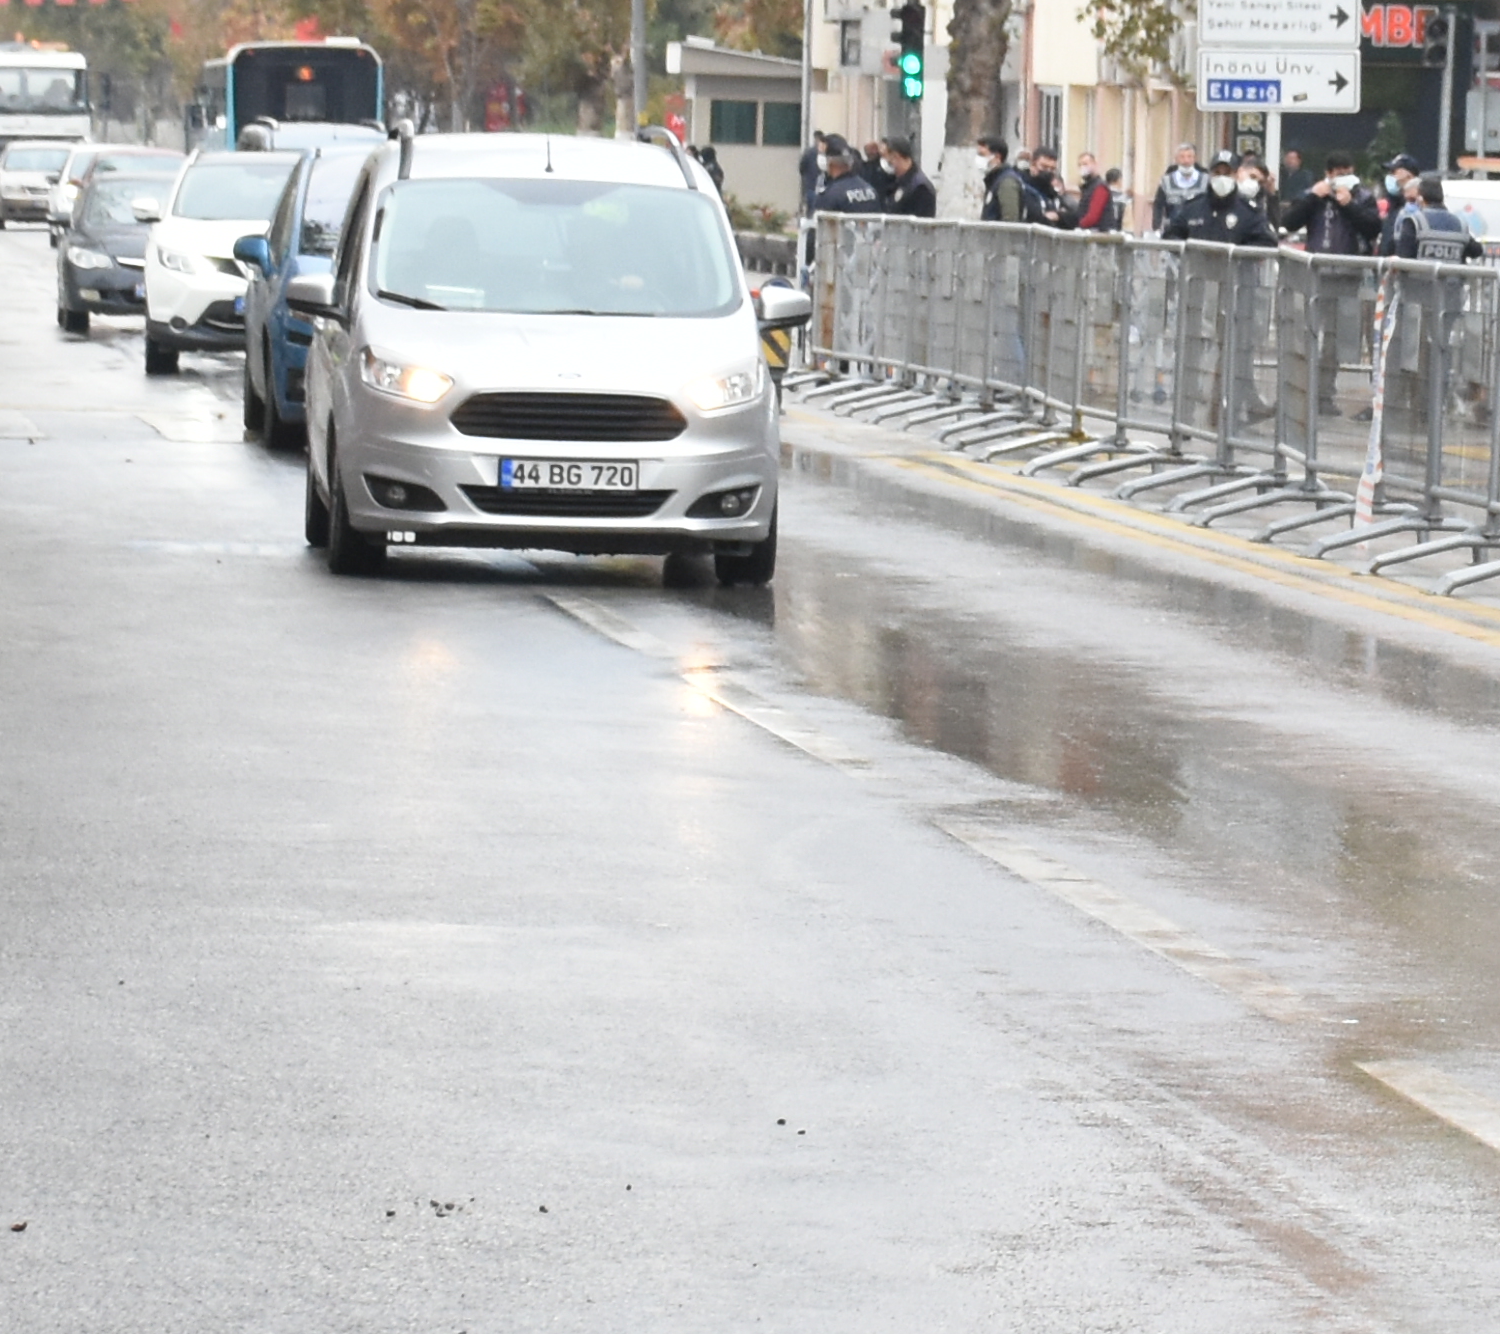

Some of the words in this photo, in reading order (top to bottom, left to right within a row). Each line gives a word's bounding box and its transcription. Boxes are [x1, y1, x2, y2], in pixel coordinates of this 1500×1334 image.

[1206, 56, 1267, 75] İnönü
[1275, 56, 1321, 75] Ünv.
[1209, 82, 1278, 102] Elazığ
[513, 463, 541, 485] 44
[549, 464, 582, 486] BG
[591, 465, 633, 488] 720
